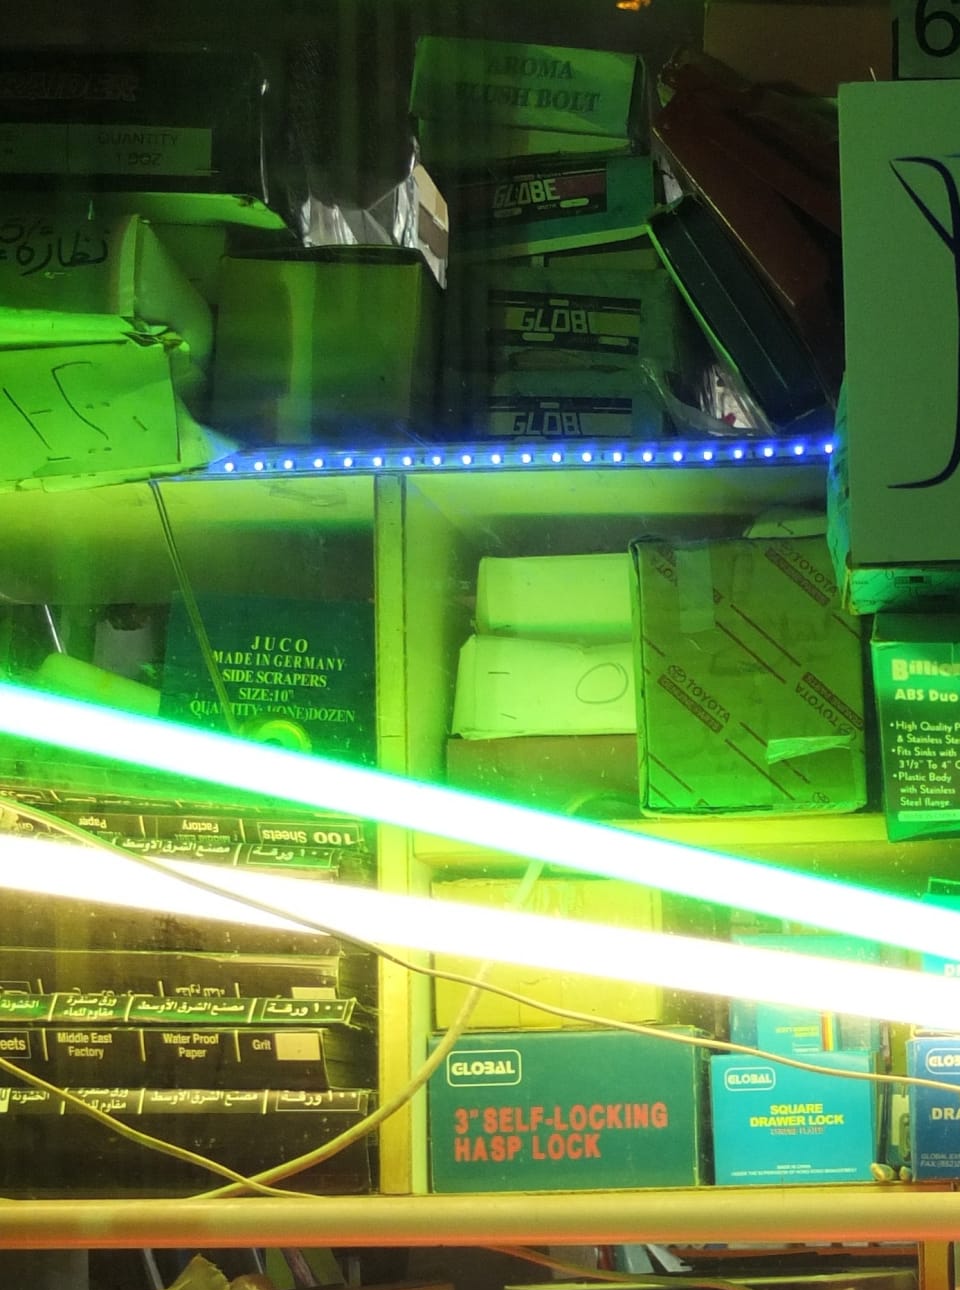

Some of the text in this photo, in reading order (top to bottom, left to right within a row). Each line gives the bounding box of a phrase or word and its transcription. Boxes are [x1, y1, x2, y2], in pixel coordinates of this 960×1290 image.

[533, 88, 601, 112] BOLT
[519, 307, 598, 335] GLOB
[512, 411, 588, 437] GLOB
[251, 635, 308, 654] JUCO
[212, 650, 346, 671] MADE IN GERMANY
[222, 668, 328, 688] SIDE SCRAPERS
[684, 677, 731, 724] TOYOTA
[895, 688, 924, 701] ABS
[929, 689, 958, 702] Duo
[190, 700, 263, 719] QUATITY:
[793, 683, 838, 728] TOYOTA
[895, 721, 917, 732] High
[920, 721, 953, 733] Quality
[906, 734, 942, 744] Stainless
[897, 746, 957, 757] Fits Sinks with
[927, 760, 937, 770] To
[898, 772, 952, 784] Plastic Body
[900, 785, 956, 795] with Stainless
[900, 797, 922, 807] Steel
[78, 816, 107, 829] Paper
[181, 819, 219, 833] Factory
[262, 829, 307, 844] Sheets
[173, 1000, 210, 1014] الشرق
[210, 1002, 245, 1015] مصنع
[266, 1002, 309, 1016] ورقة
[57, 1032, 113, 1044] Middle East
[163, 1033, 219, 1045] Water Proof
[252, 1039, 272, 1051] Grit
[68, 1046, 104, 1060] Factory
[178, 1047, 206, 1060] Paper
[451, 1060, 516, 1076] GLOBAL
[727, 1073, 772, 1085] GLOBAL
[769, 1103, 824, 1115] SQUARE
[482, 1101, 669, 1134] SELF-LOCKING
[749, 1114, 845, 1127] DRAWER LOCK
[454, 1132, 602, 1162] HASP LOCK
